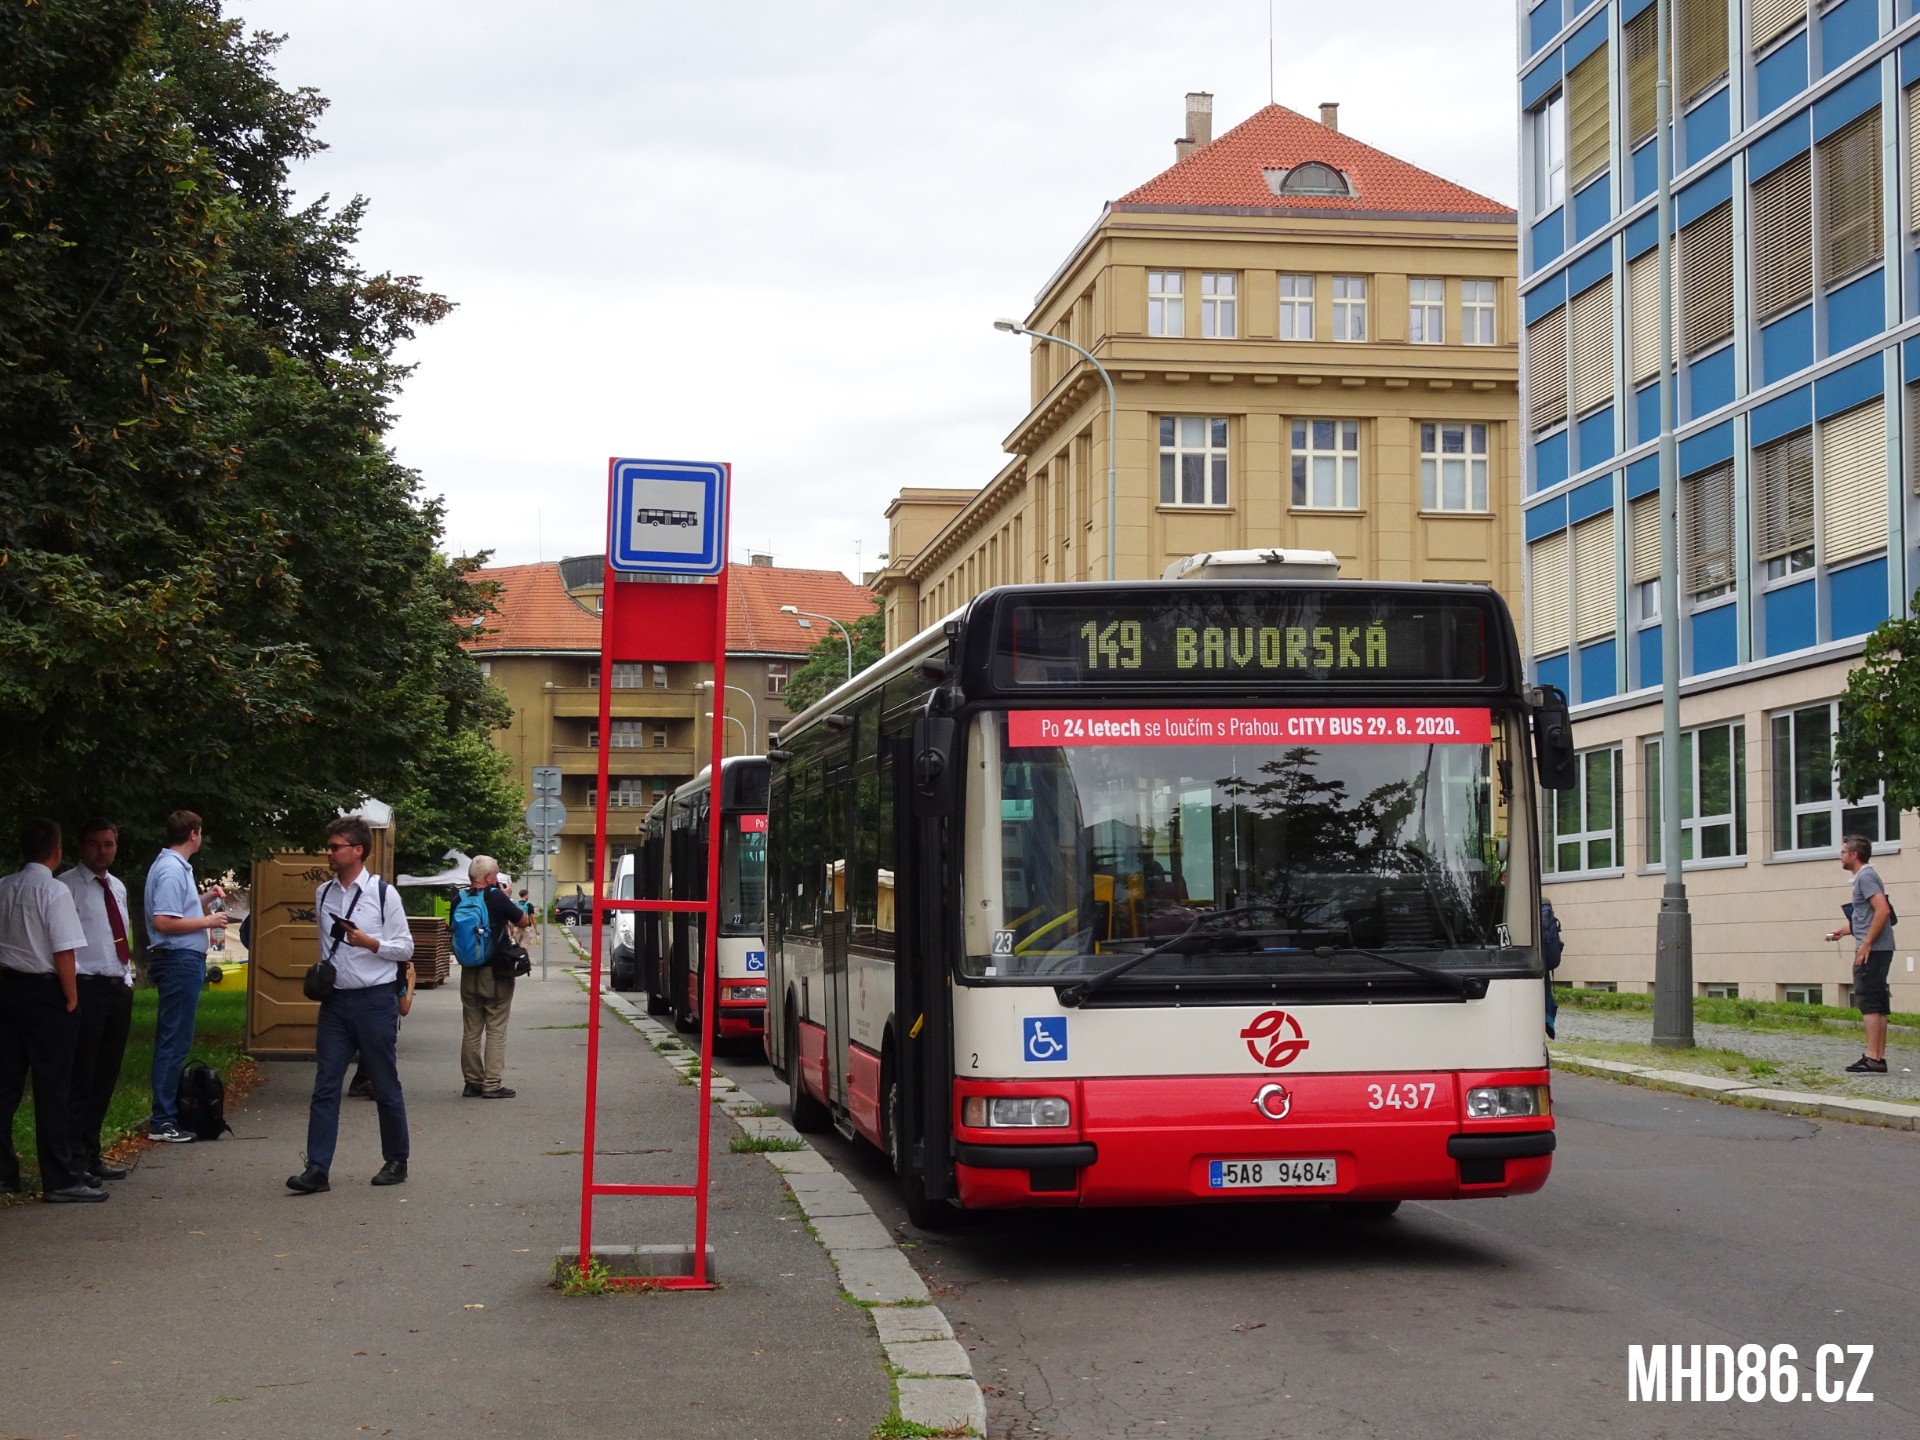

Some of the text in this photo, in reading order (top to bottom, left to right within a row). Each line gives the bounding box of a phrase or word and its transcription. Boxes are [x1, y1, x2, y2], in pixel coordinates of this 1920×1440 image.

[1081, 619, 1387, 668] 149 BAVORSKÁ
[1042, 717, 1460, 737] Po 24 letech se loučím s Prahou. CITY BUS 29. 8. 2020.
[755, 819, 765, 828] Po
[733, 914, 742, 924] 27
[994, 932, 1013, 953] 23
[1497, 926, 1510, 947] 23
[971, 1052, 979, 1069] 2
[1367, 1083, 1436, 1110] 3437
[1212, 1177, 1222, 1185] CZ
[1226, 1162, 1327, 1184] 5A8 9484
